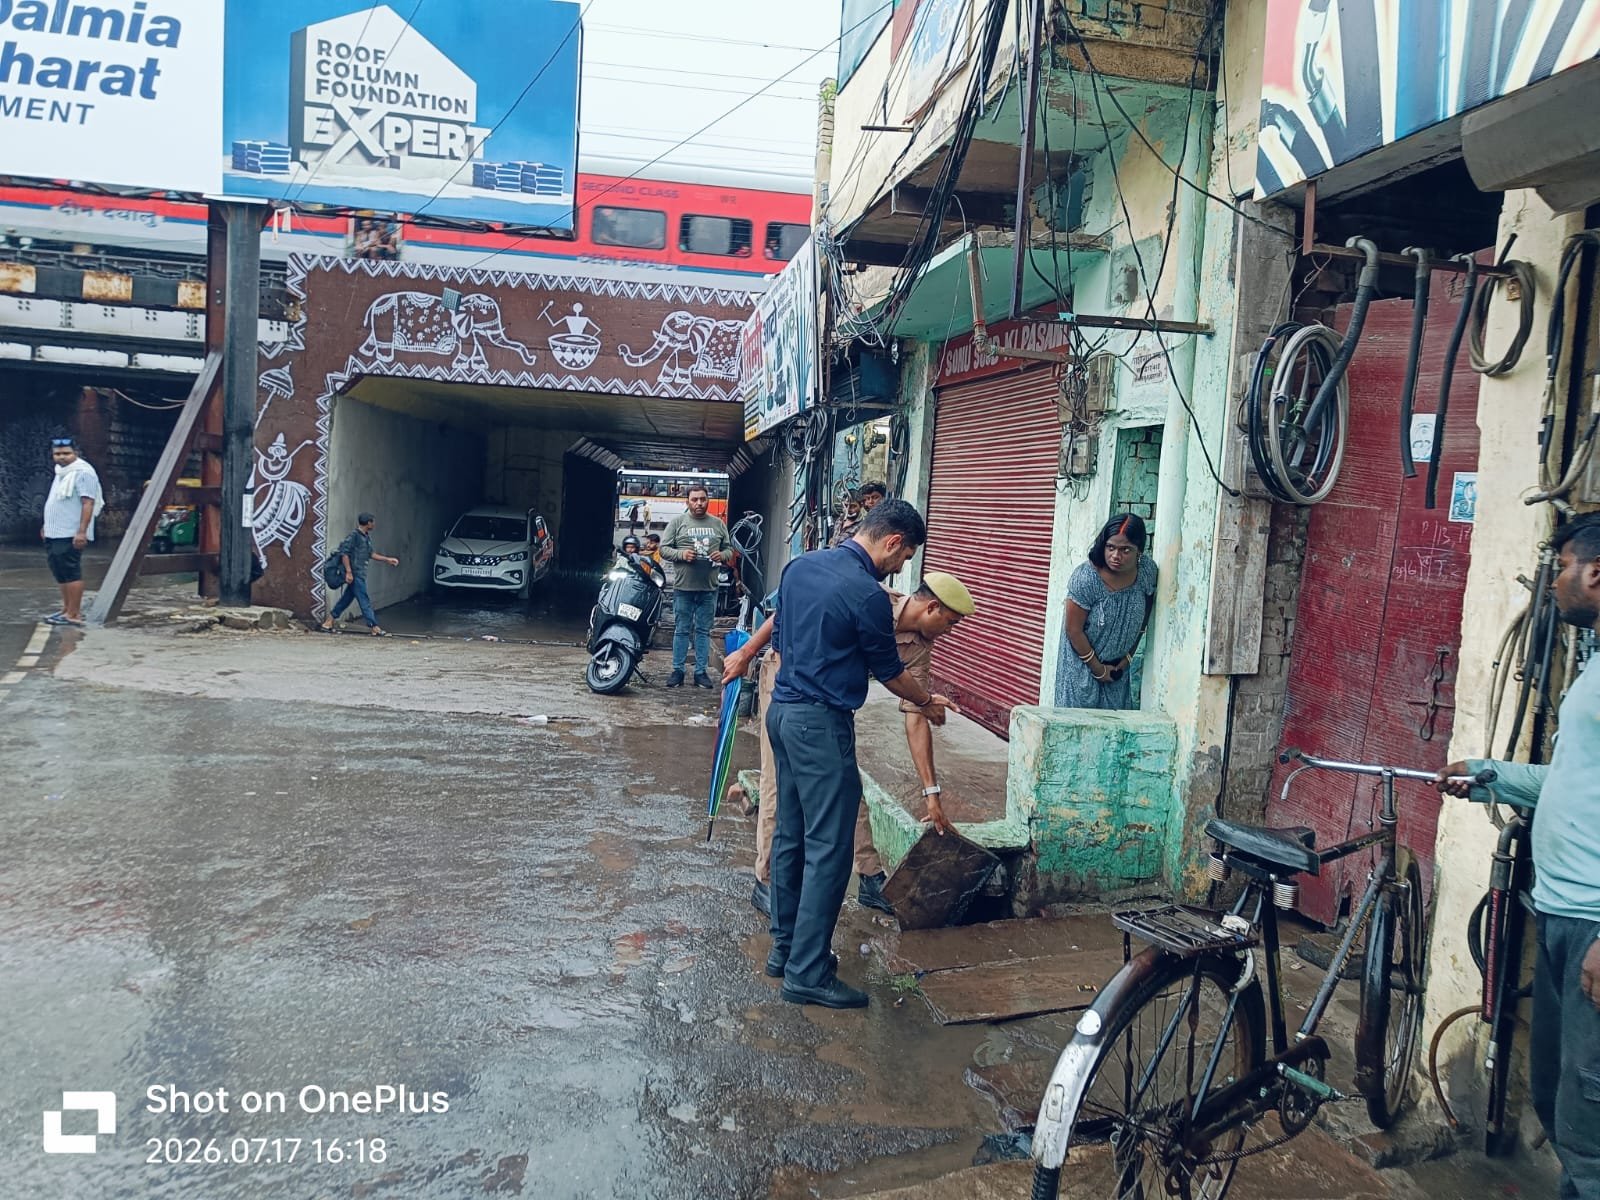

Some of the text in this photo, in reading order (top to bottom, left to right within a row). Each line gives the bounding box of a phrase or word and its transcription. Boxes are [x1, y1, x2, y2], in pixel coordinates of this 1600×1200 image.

[317, 39, 386, 65] ROOF
[316, 59, 420, 90] COLUMN
[316, 78, 468, 114] FOUNDATION
[303, 103, 492, 164] EXPERT
[582, 182, 680, 199] SECOND CLASS
[58, 198, 94, 217] दीन
[945, 344, 972, 377] SONU
